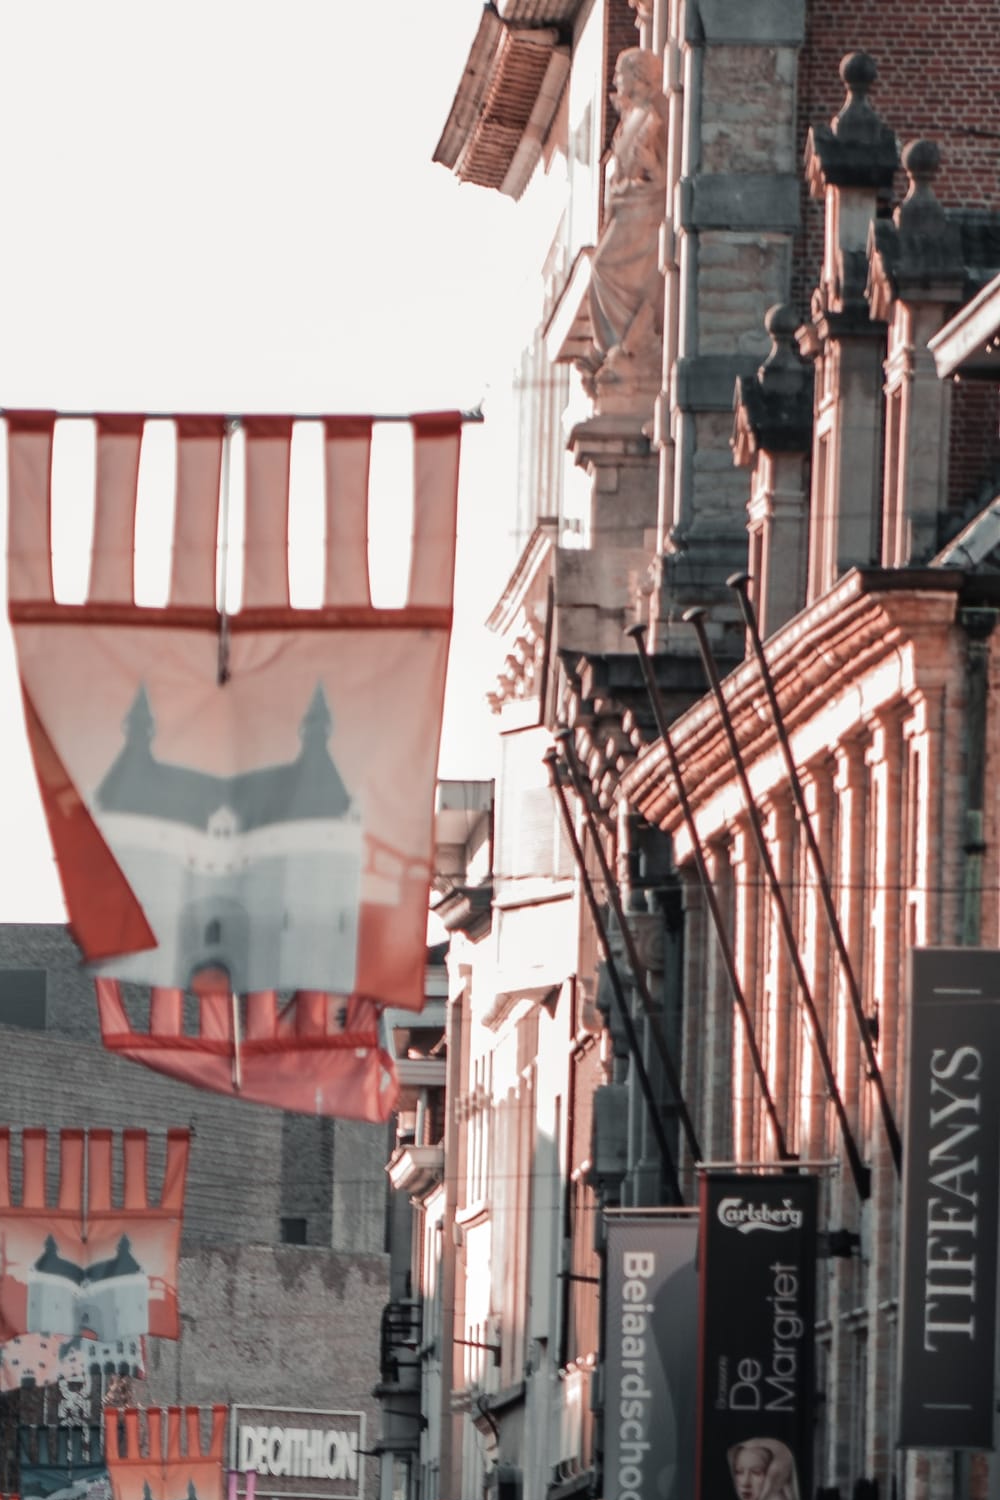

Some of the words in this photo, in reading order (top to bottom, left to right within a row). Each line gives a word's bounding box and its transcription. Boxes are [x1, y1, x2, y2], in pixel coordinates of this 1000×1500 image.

[717, 1197, 804, 1233] Carlsberg
[924, 1046, 983, 1352] TIFFANYS
[764, 1261, 804, 1412] Margriet
[729, 1357, 762, 1411] De
[239, 1424, 358, 1480] DECATHLON
